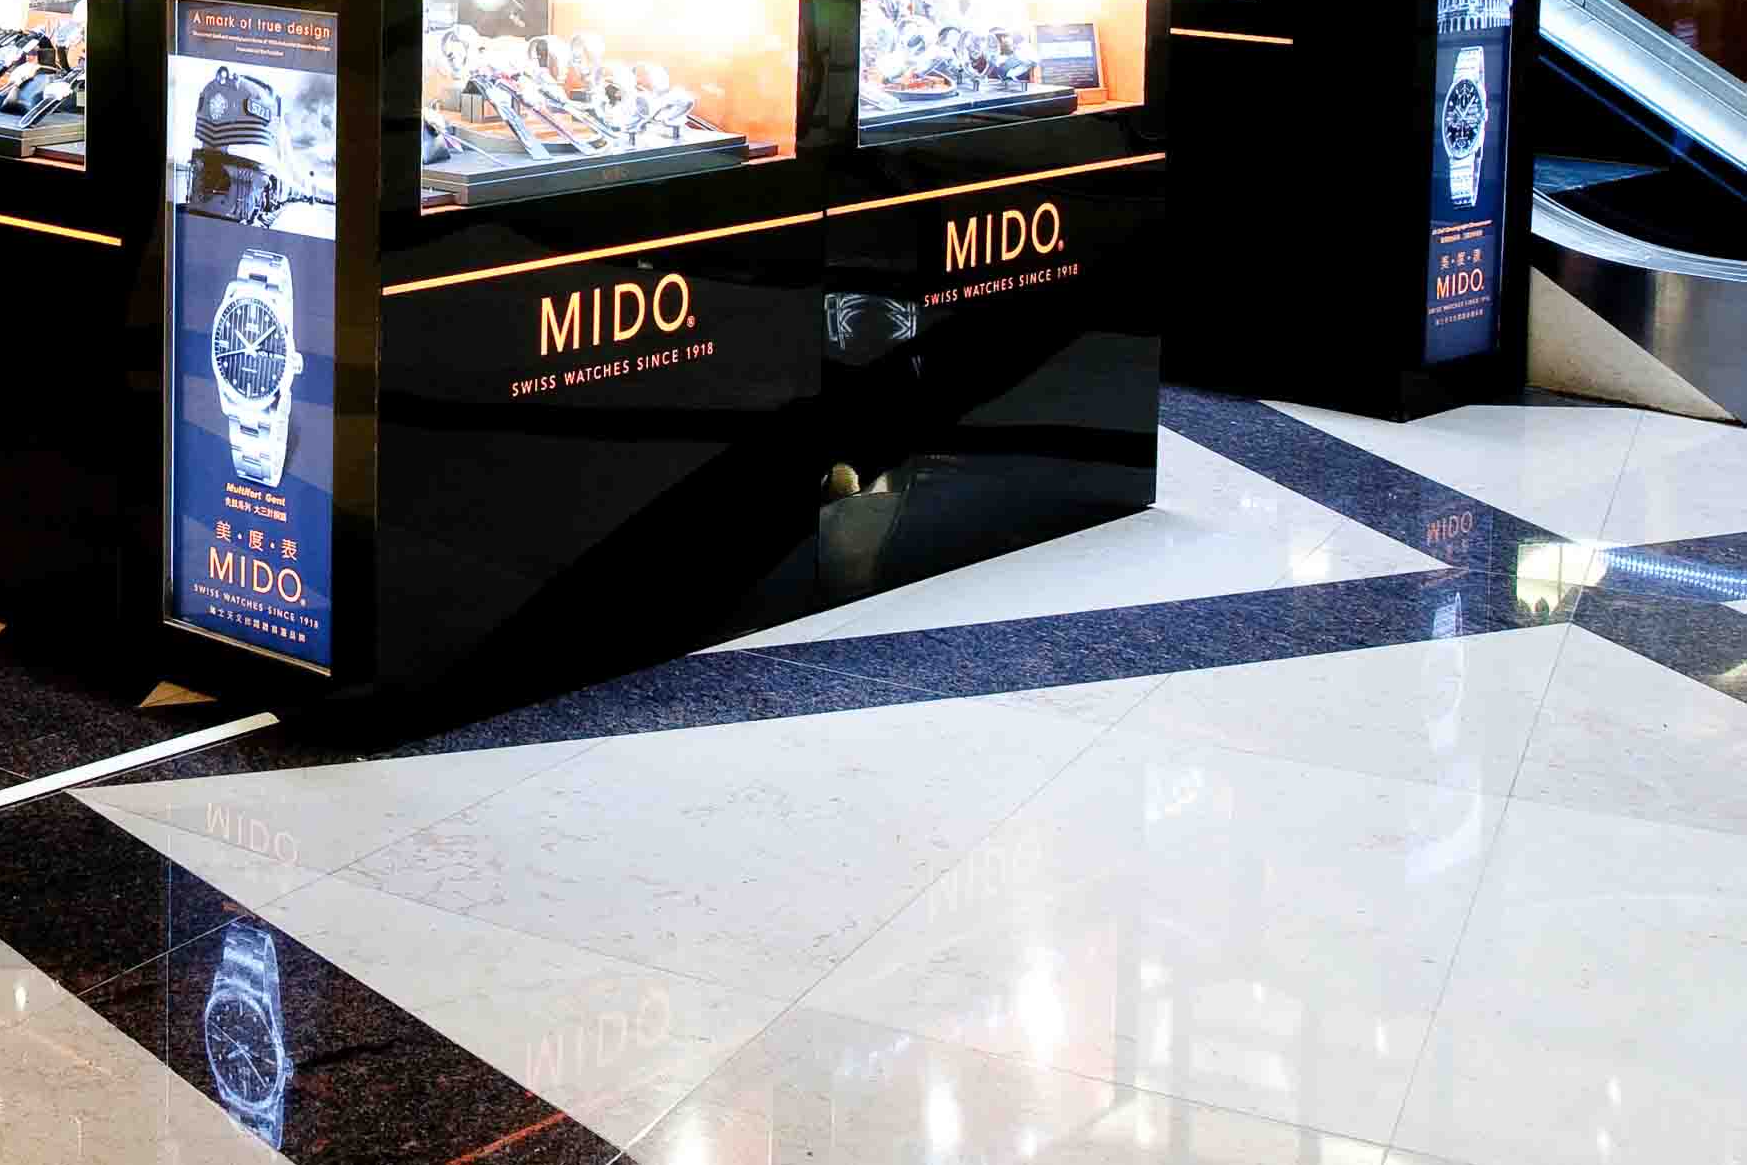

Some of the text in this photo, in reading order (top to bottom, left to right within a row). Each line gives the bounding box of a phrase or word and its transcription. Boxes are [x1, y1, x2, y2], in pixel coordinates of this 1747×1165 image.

[193, 12, 330, 39] A mark of true design
[945, 202, 1061, 272] MIDO
[923, 262, 1079, 308] SWISS WATCHES SINCE 1918
[1436, 268, 1483, 300] MIDO
[540, 273, 690, 356] MIDO
[511, 341, 715, 398] SWISS WATCHES SINCE 1918
[209, 546, 302, 603] MIDO
[193, 584, 219, 598] SWISS
[223, 592, 264, 612] WATCHES
[268, 605, 295, 622] SINCE
